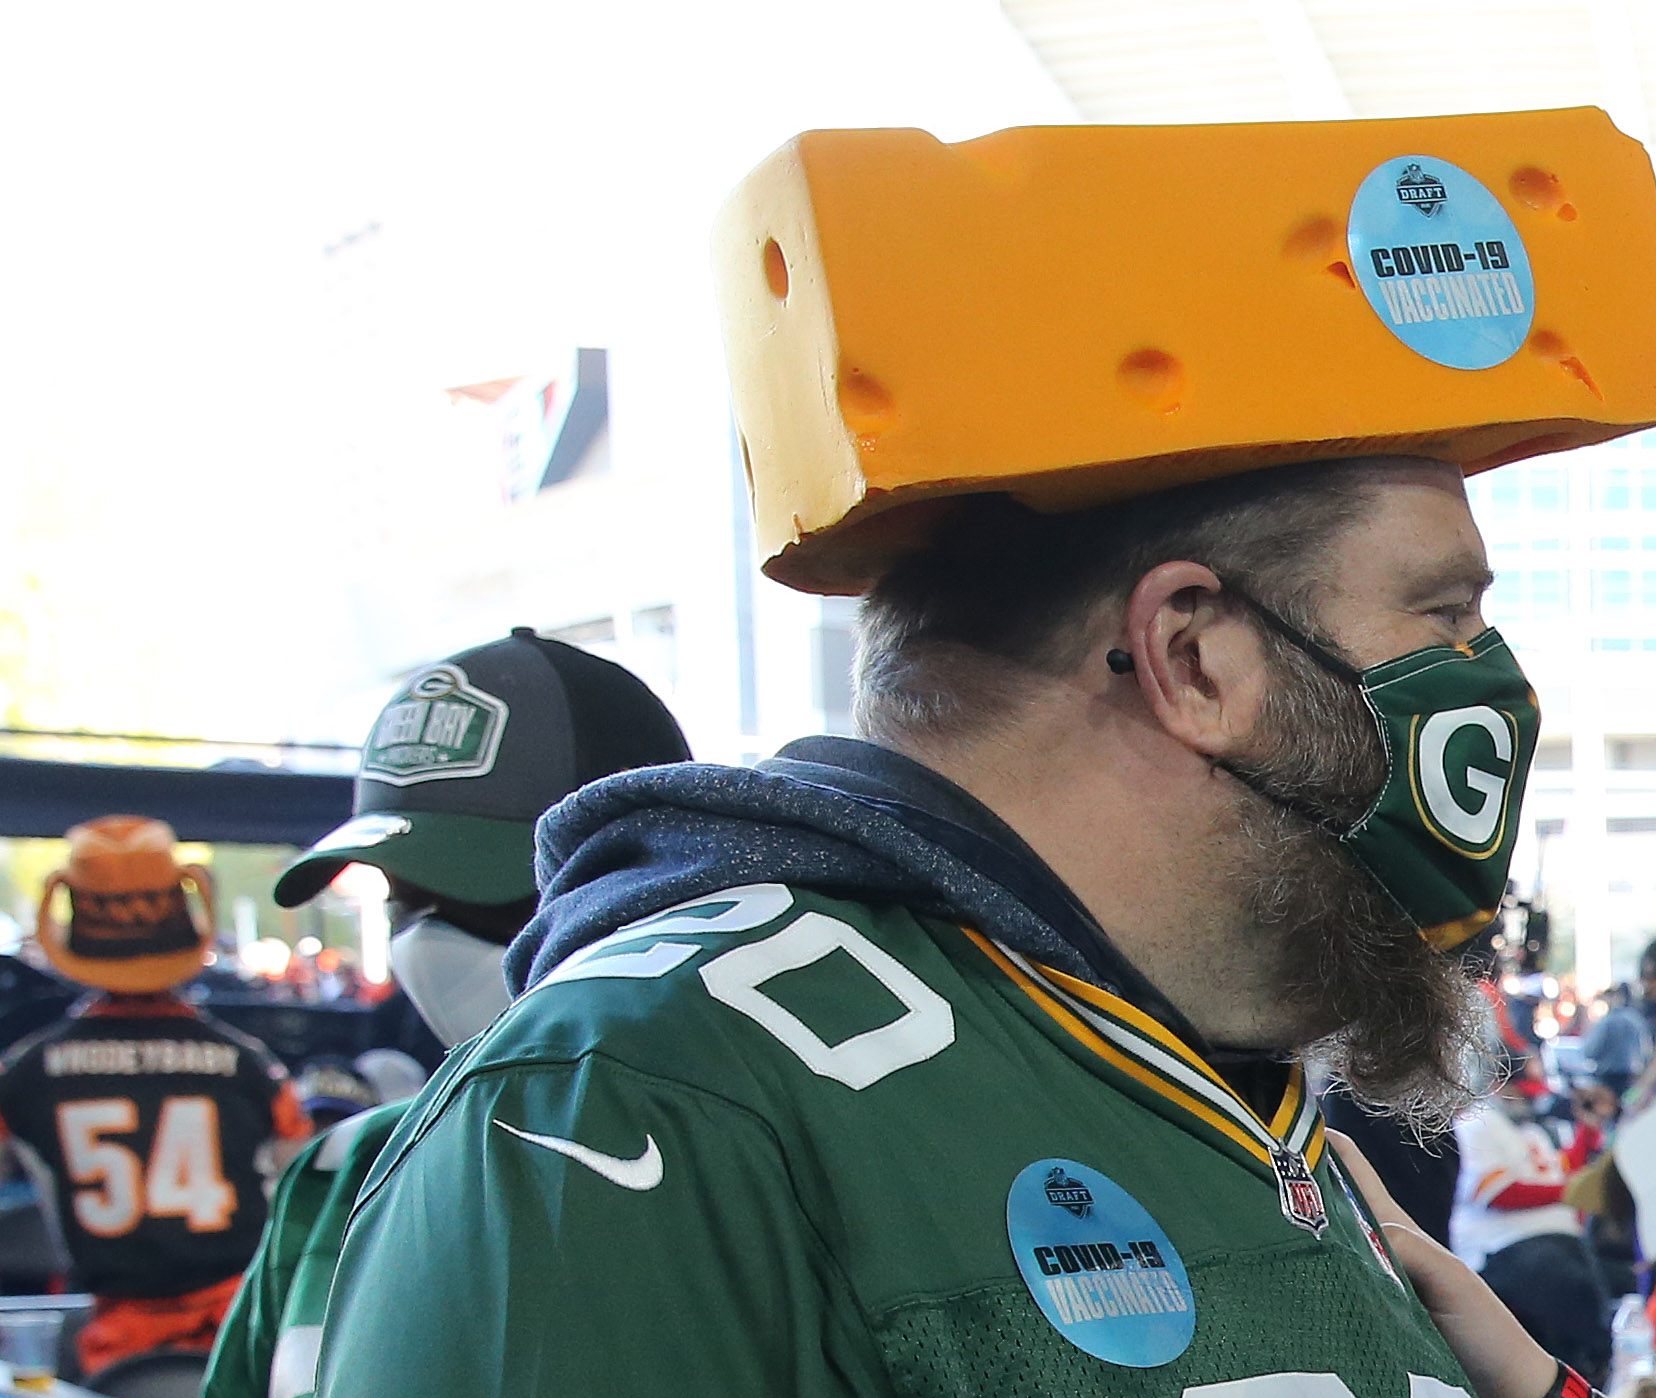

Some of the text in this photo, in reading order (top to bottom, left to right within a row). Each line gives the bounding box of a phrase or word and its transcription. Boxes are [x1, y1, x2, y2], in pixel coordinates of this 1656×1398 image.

[1399, 186, 1446, 201] DRAFT
[1371, 241, 1511, 278] COVID-19
[1378, 272, 1526, 325] VACCINATED
[1419, 705, 1513, 845] G
[55, 1096, 241, 1238] 54
[1048, 1189, 1090, 1204] DRAFT
[1033, 1240, 1166, 1277] COVID-19
[1044, 1270, 1189, 1325] VACCINATED
